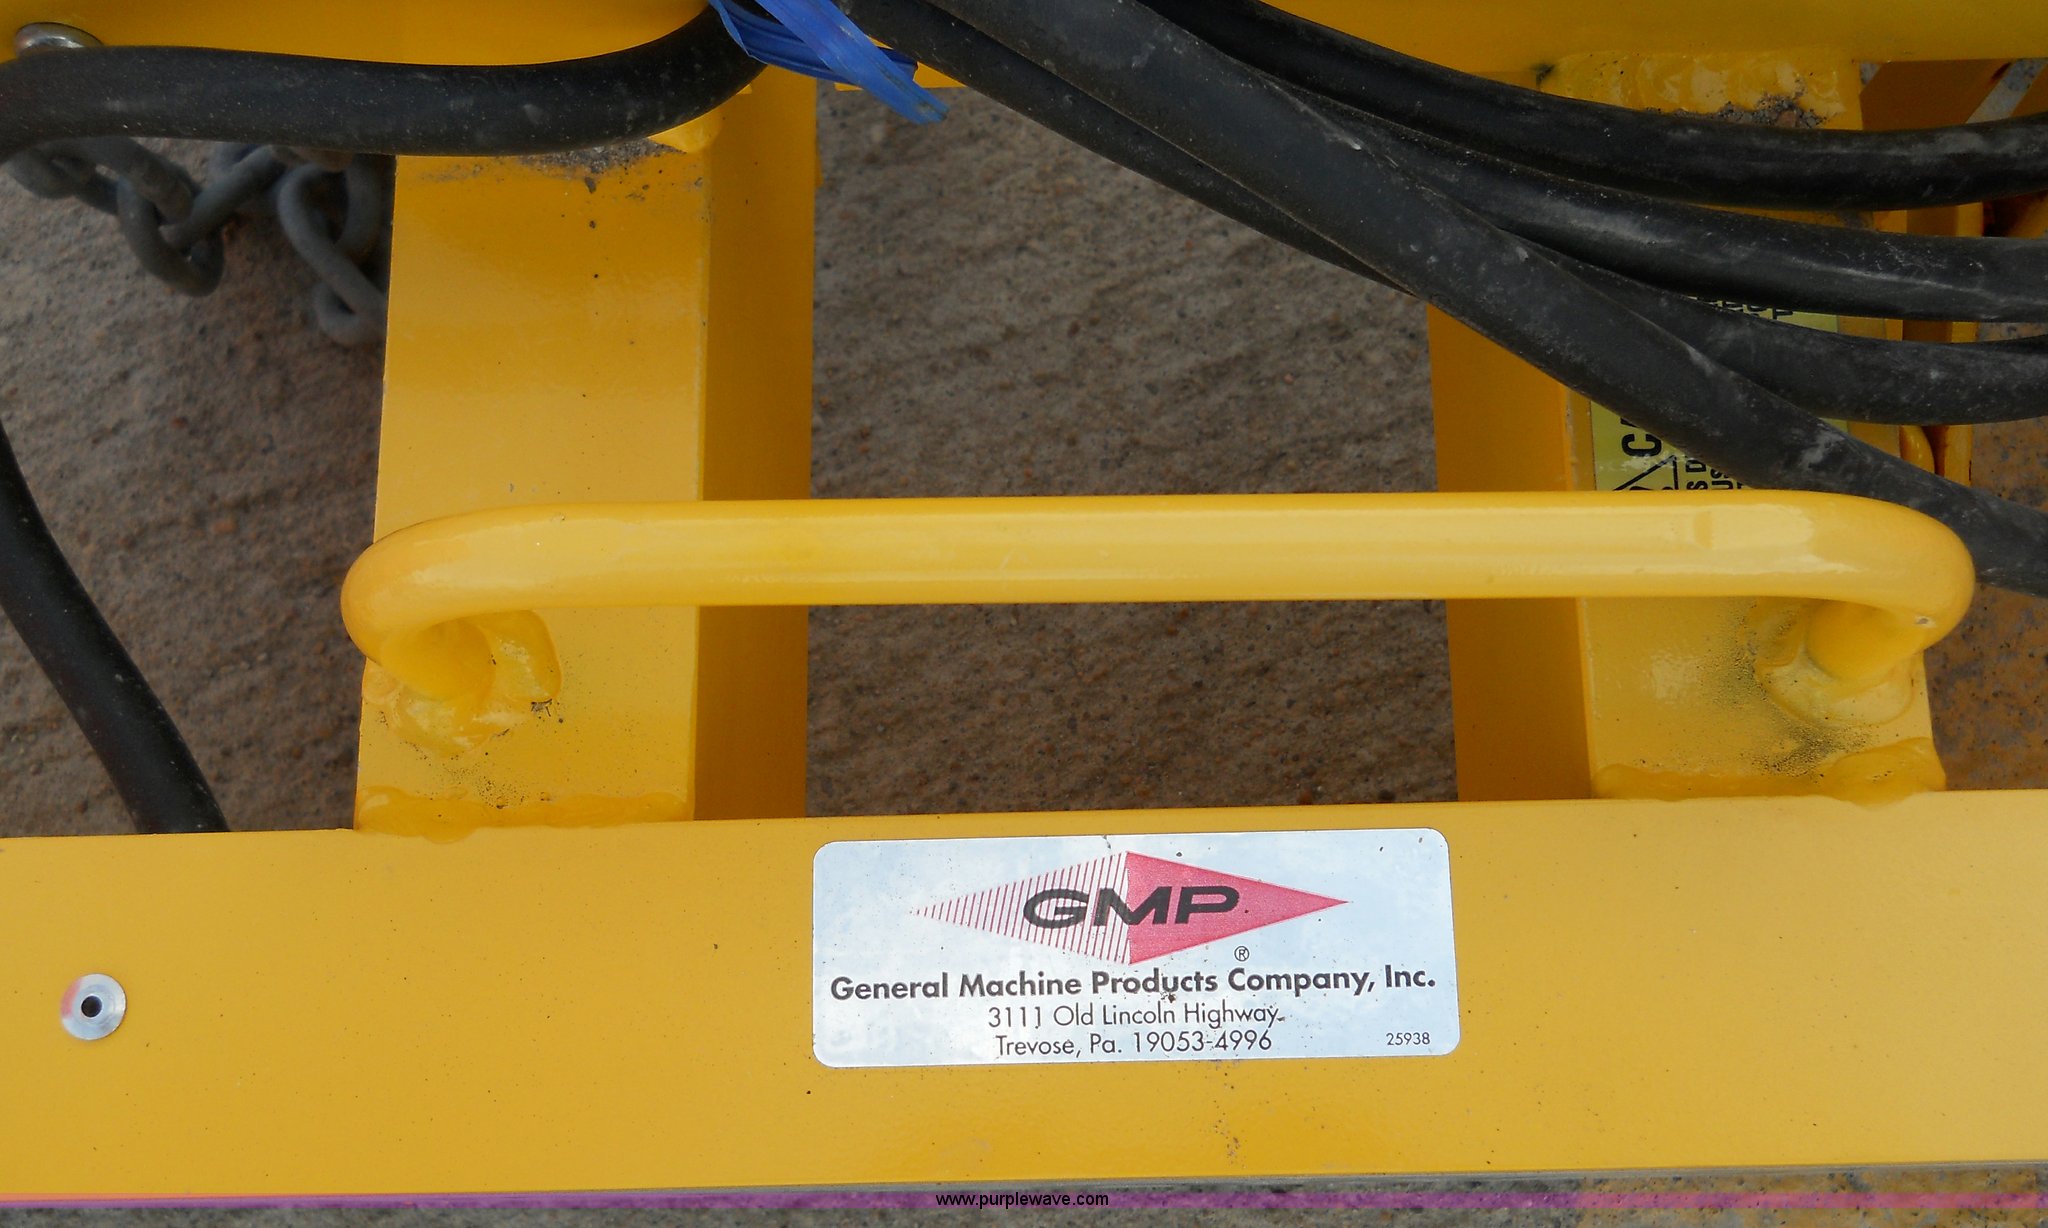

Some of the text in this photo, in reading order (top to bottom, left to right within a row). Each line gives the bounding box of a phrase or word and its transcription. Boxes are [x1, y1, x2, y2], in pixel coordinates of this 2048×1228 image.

[1023, 885, 1240, 929] GMP
[831, 965, 1437, 1000] General Machine Products Company, Inc.
[988, 999, 1280, 1029] 3111 Old Lincoln Highway
[995, 1030, 1272, 1058] Trevose, Pa. 19053-4996
[1386, 1032, 1431, 1047] 25938
